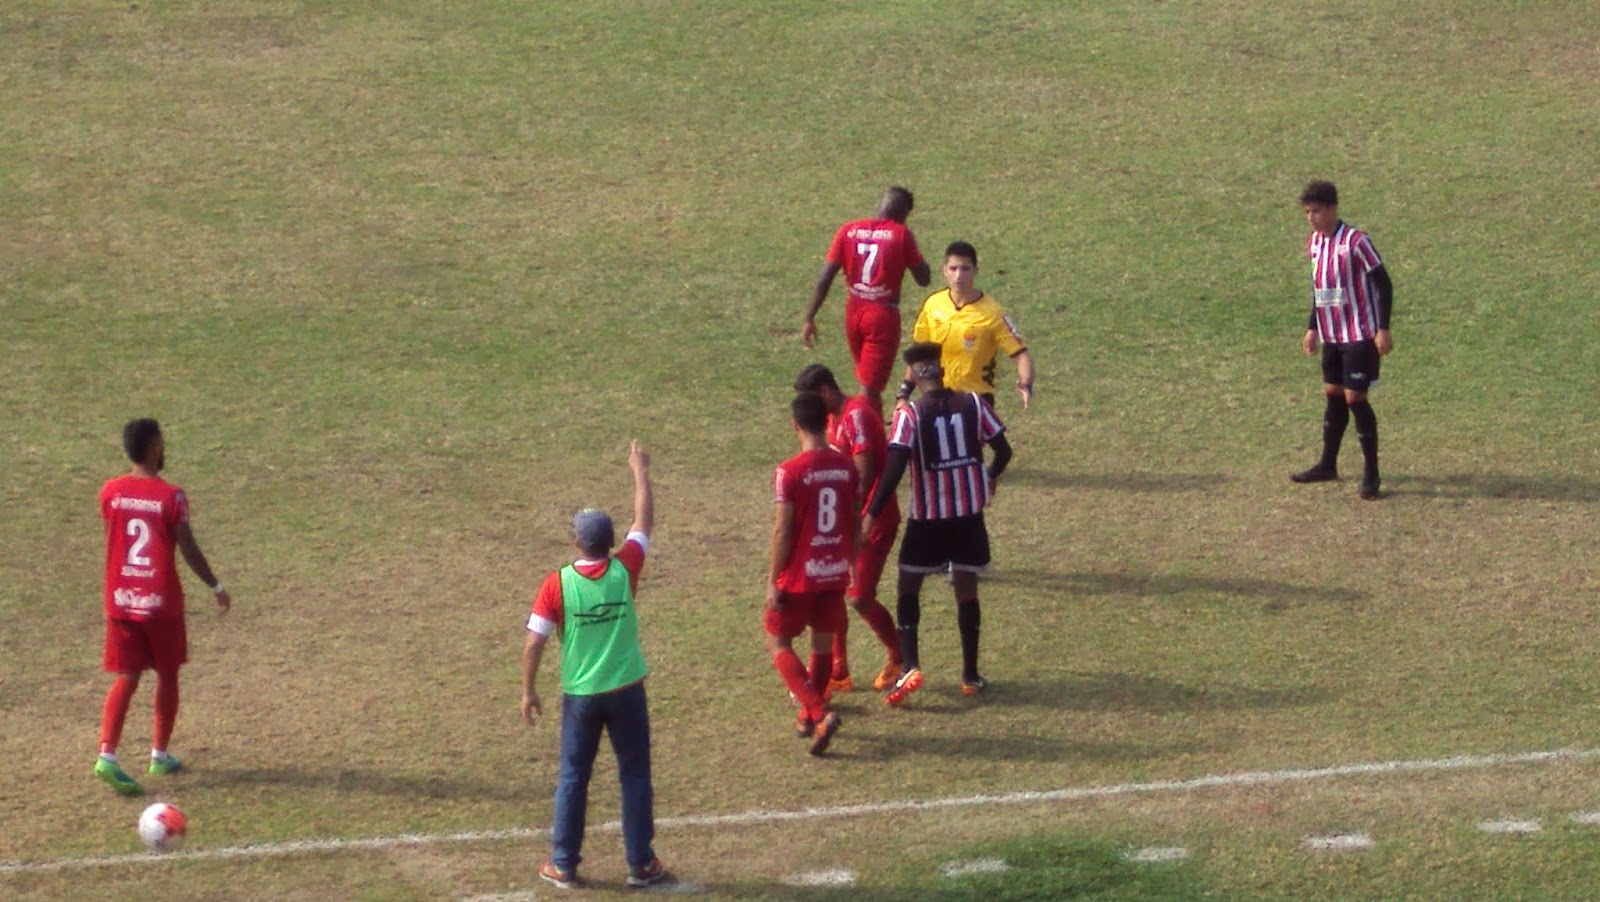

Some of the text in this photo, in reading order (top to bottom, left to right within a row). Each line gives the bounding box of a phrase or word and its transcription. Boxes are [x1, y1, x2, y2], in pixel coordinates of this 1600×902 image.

[857, 243, 879, 284] 7
[934, 412, 967, 460] 11
[818, 487, 837, 533] 8
[127, 518, 150, 566] 2
